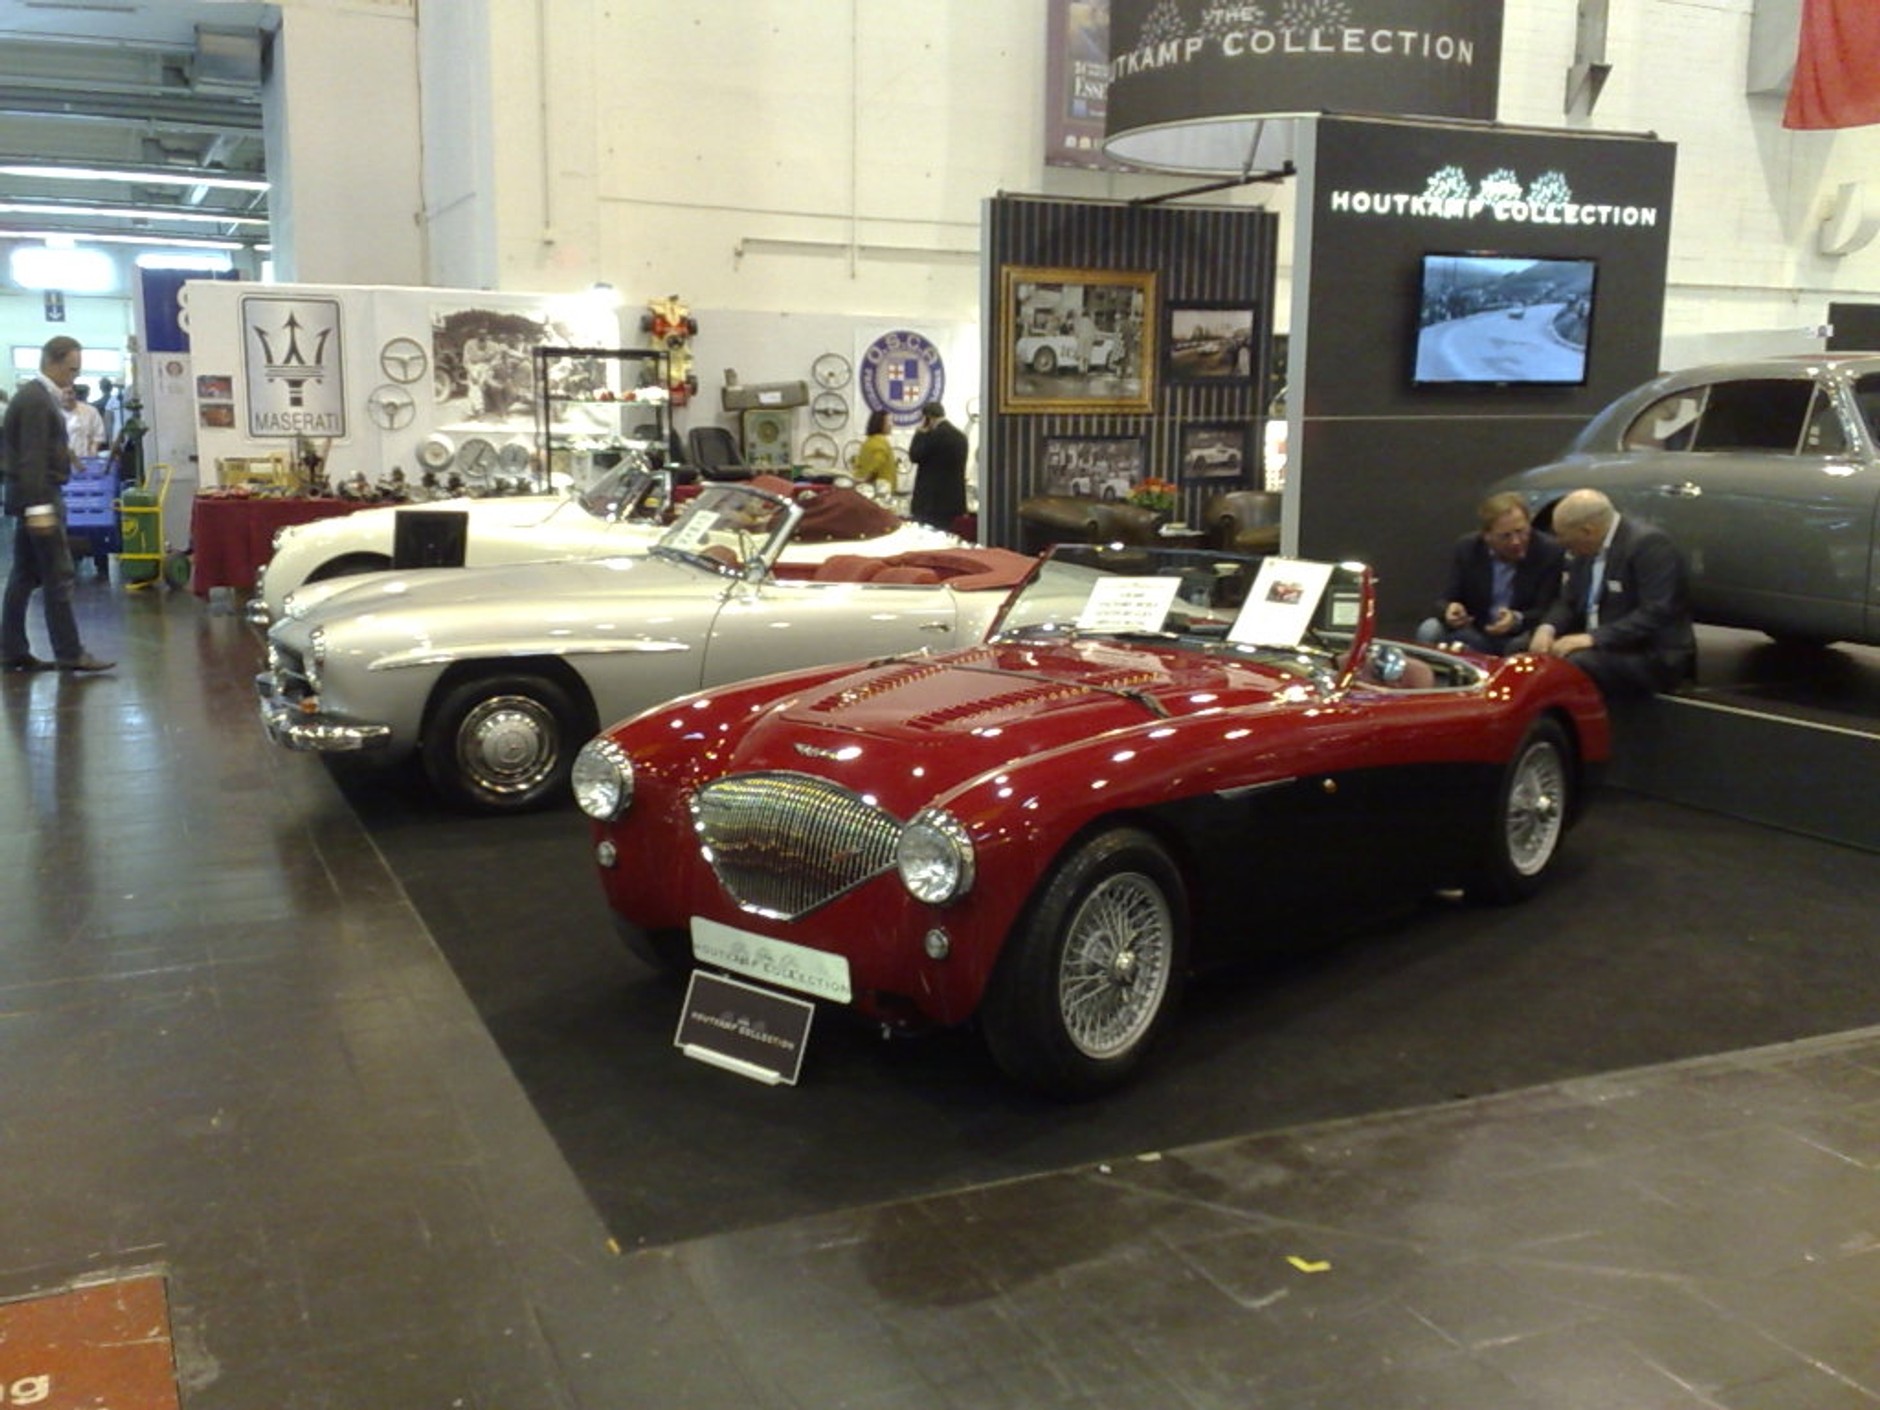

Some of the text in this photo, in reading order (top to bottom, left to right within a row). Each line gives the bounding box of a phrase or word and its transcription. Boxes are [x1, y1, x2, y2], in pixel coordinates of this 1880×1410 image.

[1222, 28, 1474, 66] COLLECTION
[1331, 190, 1658, 227] HOUTKAMP COLLECTION
[255, 411, 341, 431] MASERATI
[0, 1373, 50, 1406] g
